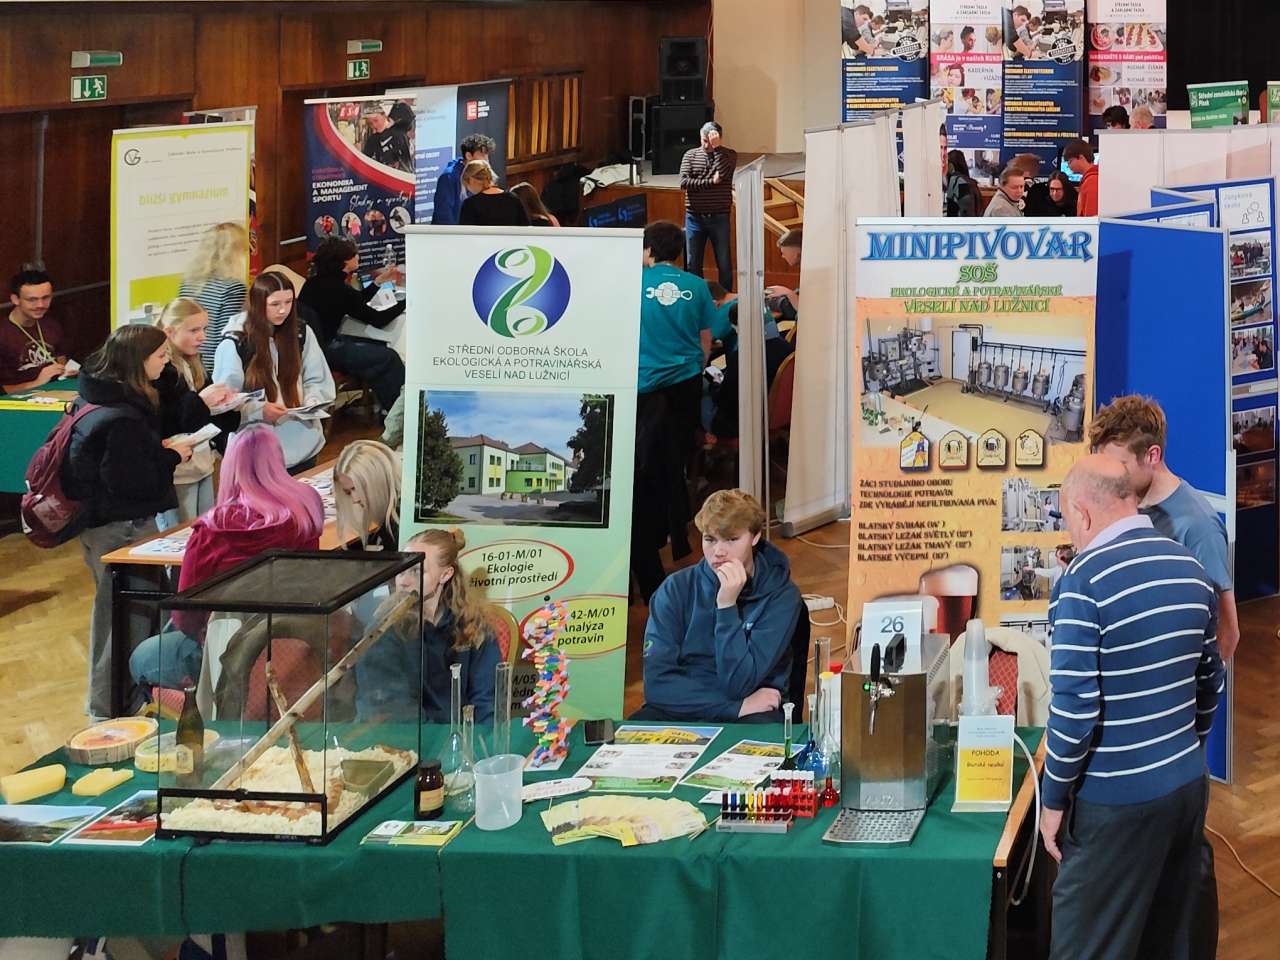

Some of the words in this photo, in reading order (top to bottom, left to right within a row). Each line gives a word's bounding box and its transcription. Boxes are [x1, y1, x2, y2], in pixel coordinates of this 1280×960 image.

[321, 184, 368, 195] MANAGEMENT
[313, 195, 342, 204] SPORTU
[861, 224, 1094, 262] MINIPIVOVAR
[957, 263, 998, 283] SOŠ
[904, 297, 957, 314] VESELÍ
[959, 298, 992, 313] NAD
[993, 296, 1050, 313] LUŽNICÍ
[448, 344, 494, 355] STŘEDNÍ
[497, 345, 551, 356] ODBORNÁ
[553, 345, 588, 357] ŠKOLA
[433, 355, 501, 367] EKOLOGICKÁ
[504, 358, 511, 367] A
[514, 356, 602, 369] POTRAVINÁŘSKÁ
[464, 368, 501, 379] VESELÍ
[504, 370, 526, 380] NAD
[529, 368, 570, 381] LUŽNICÍ
[481, 549, 543, 562] 16-01-M/01
[487, 561, 534, 574] Ekologie
[508, 571, 558, 587] prostředí
[570, 606, 616, 619] 42-M/01
[880, 615, 905, 633] 26
[557, 633, 605, 647] potravin
